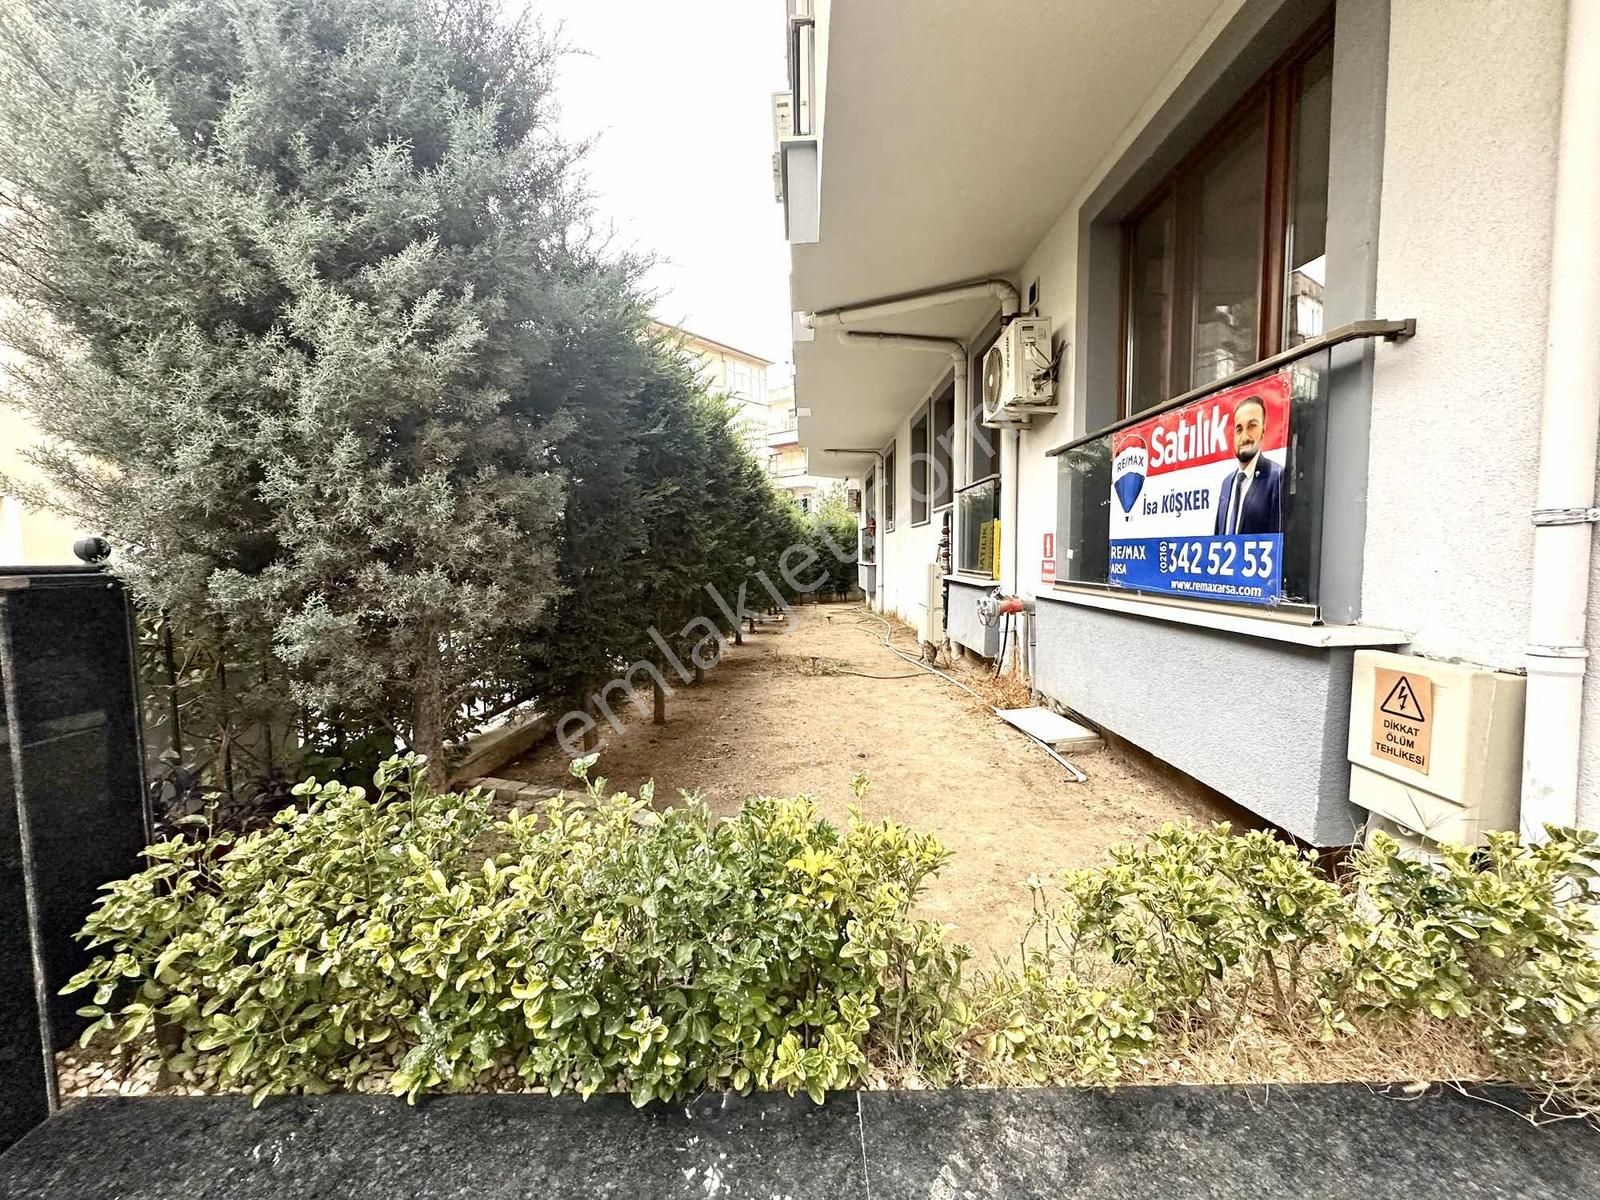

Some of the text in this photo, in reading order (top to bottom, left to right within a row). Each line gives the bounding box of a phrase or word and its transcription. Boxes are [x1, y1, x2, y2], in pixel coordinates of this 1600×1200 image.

[1150, 405, 1229, 468] Satılık
[1116, 454, 1145, 473] RE/MAX
[1142, 487, 1210, 518] İsa KÖŞKER
[1110, 544, 1147, 560] RE/MAX
[1159, 540, 1274, 579] (0216) 342 52 53
[1110, 562, 1127, 576] ARSA
[1170, 579, 1262, 597] www.remaxarsa.com
[1384, 719, 1420, 736] DİKKAT
[1386, 731, 1415, 749] ÖLÜM
[1375, 742, 1425, 766] TEHLİKESİ
